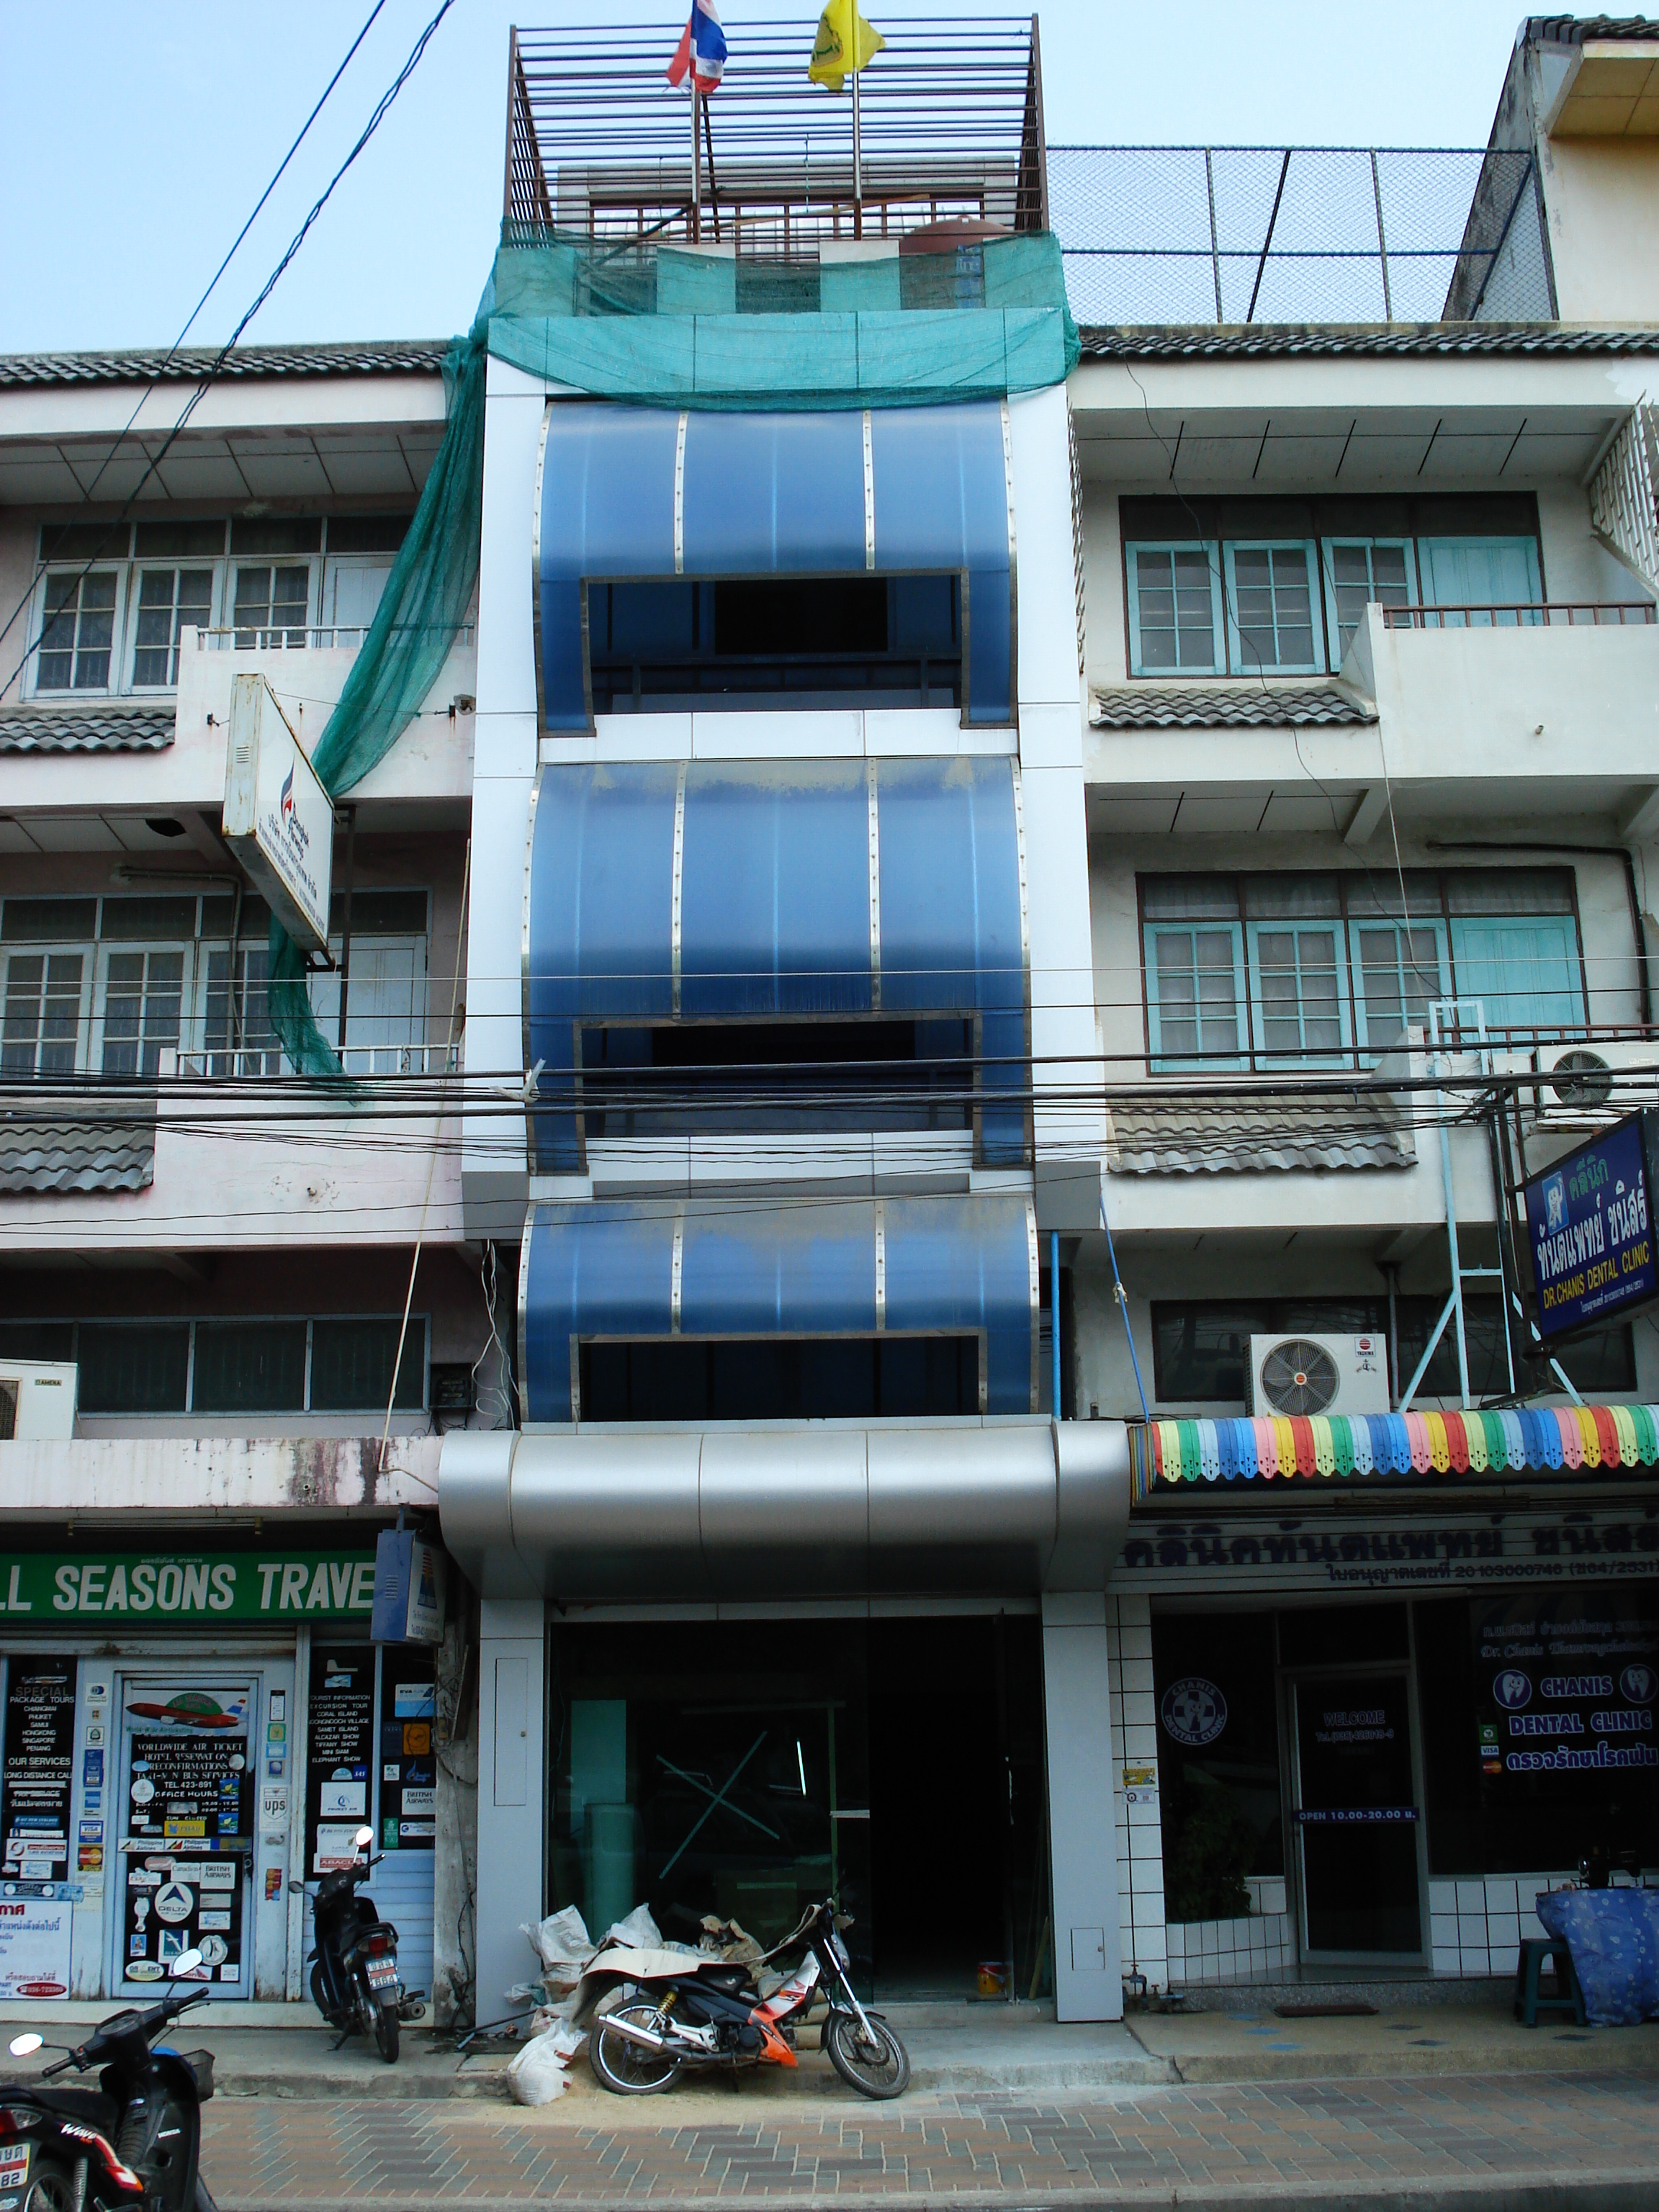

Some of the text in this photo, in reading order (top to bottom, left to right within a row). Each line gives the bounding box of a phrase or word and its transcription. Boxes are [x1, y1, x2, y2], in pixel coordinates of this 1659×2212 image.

[1587, 1257, 1619, 1291] DENTAL
[1622, 1240, 1650, 1274] CLINIC
[0, 1565, 31, 1611] L
[53, 1564, 236, 1611] SEASONS
[16, 1686, 69, 1696] SPECIAL
[1172, 1681, 1215, 1696] CHANIS
[1540, 1676, 1614, 1697] CHANIS
[1323, 1710, 1385, 1726] WELCOME
[1509, 1710, 1653, 1736] DENTAL CLINIC
[1165, 1714, 1224, 1741] DENTAL CLINIC
[29, 1757, 71, 1766] SERVICES
[265, 1800, 286, 1815] ups
[1299, 1811, 1326, 1820] OPEN
[1331, 1809, 1401, 1820] 10.00-20.00
[60, 2123, 98, 2139] Wave
